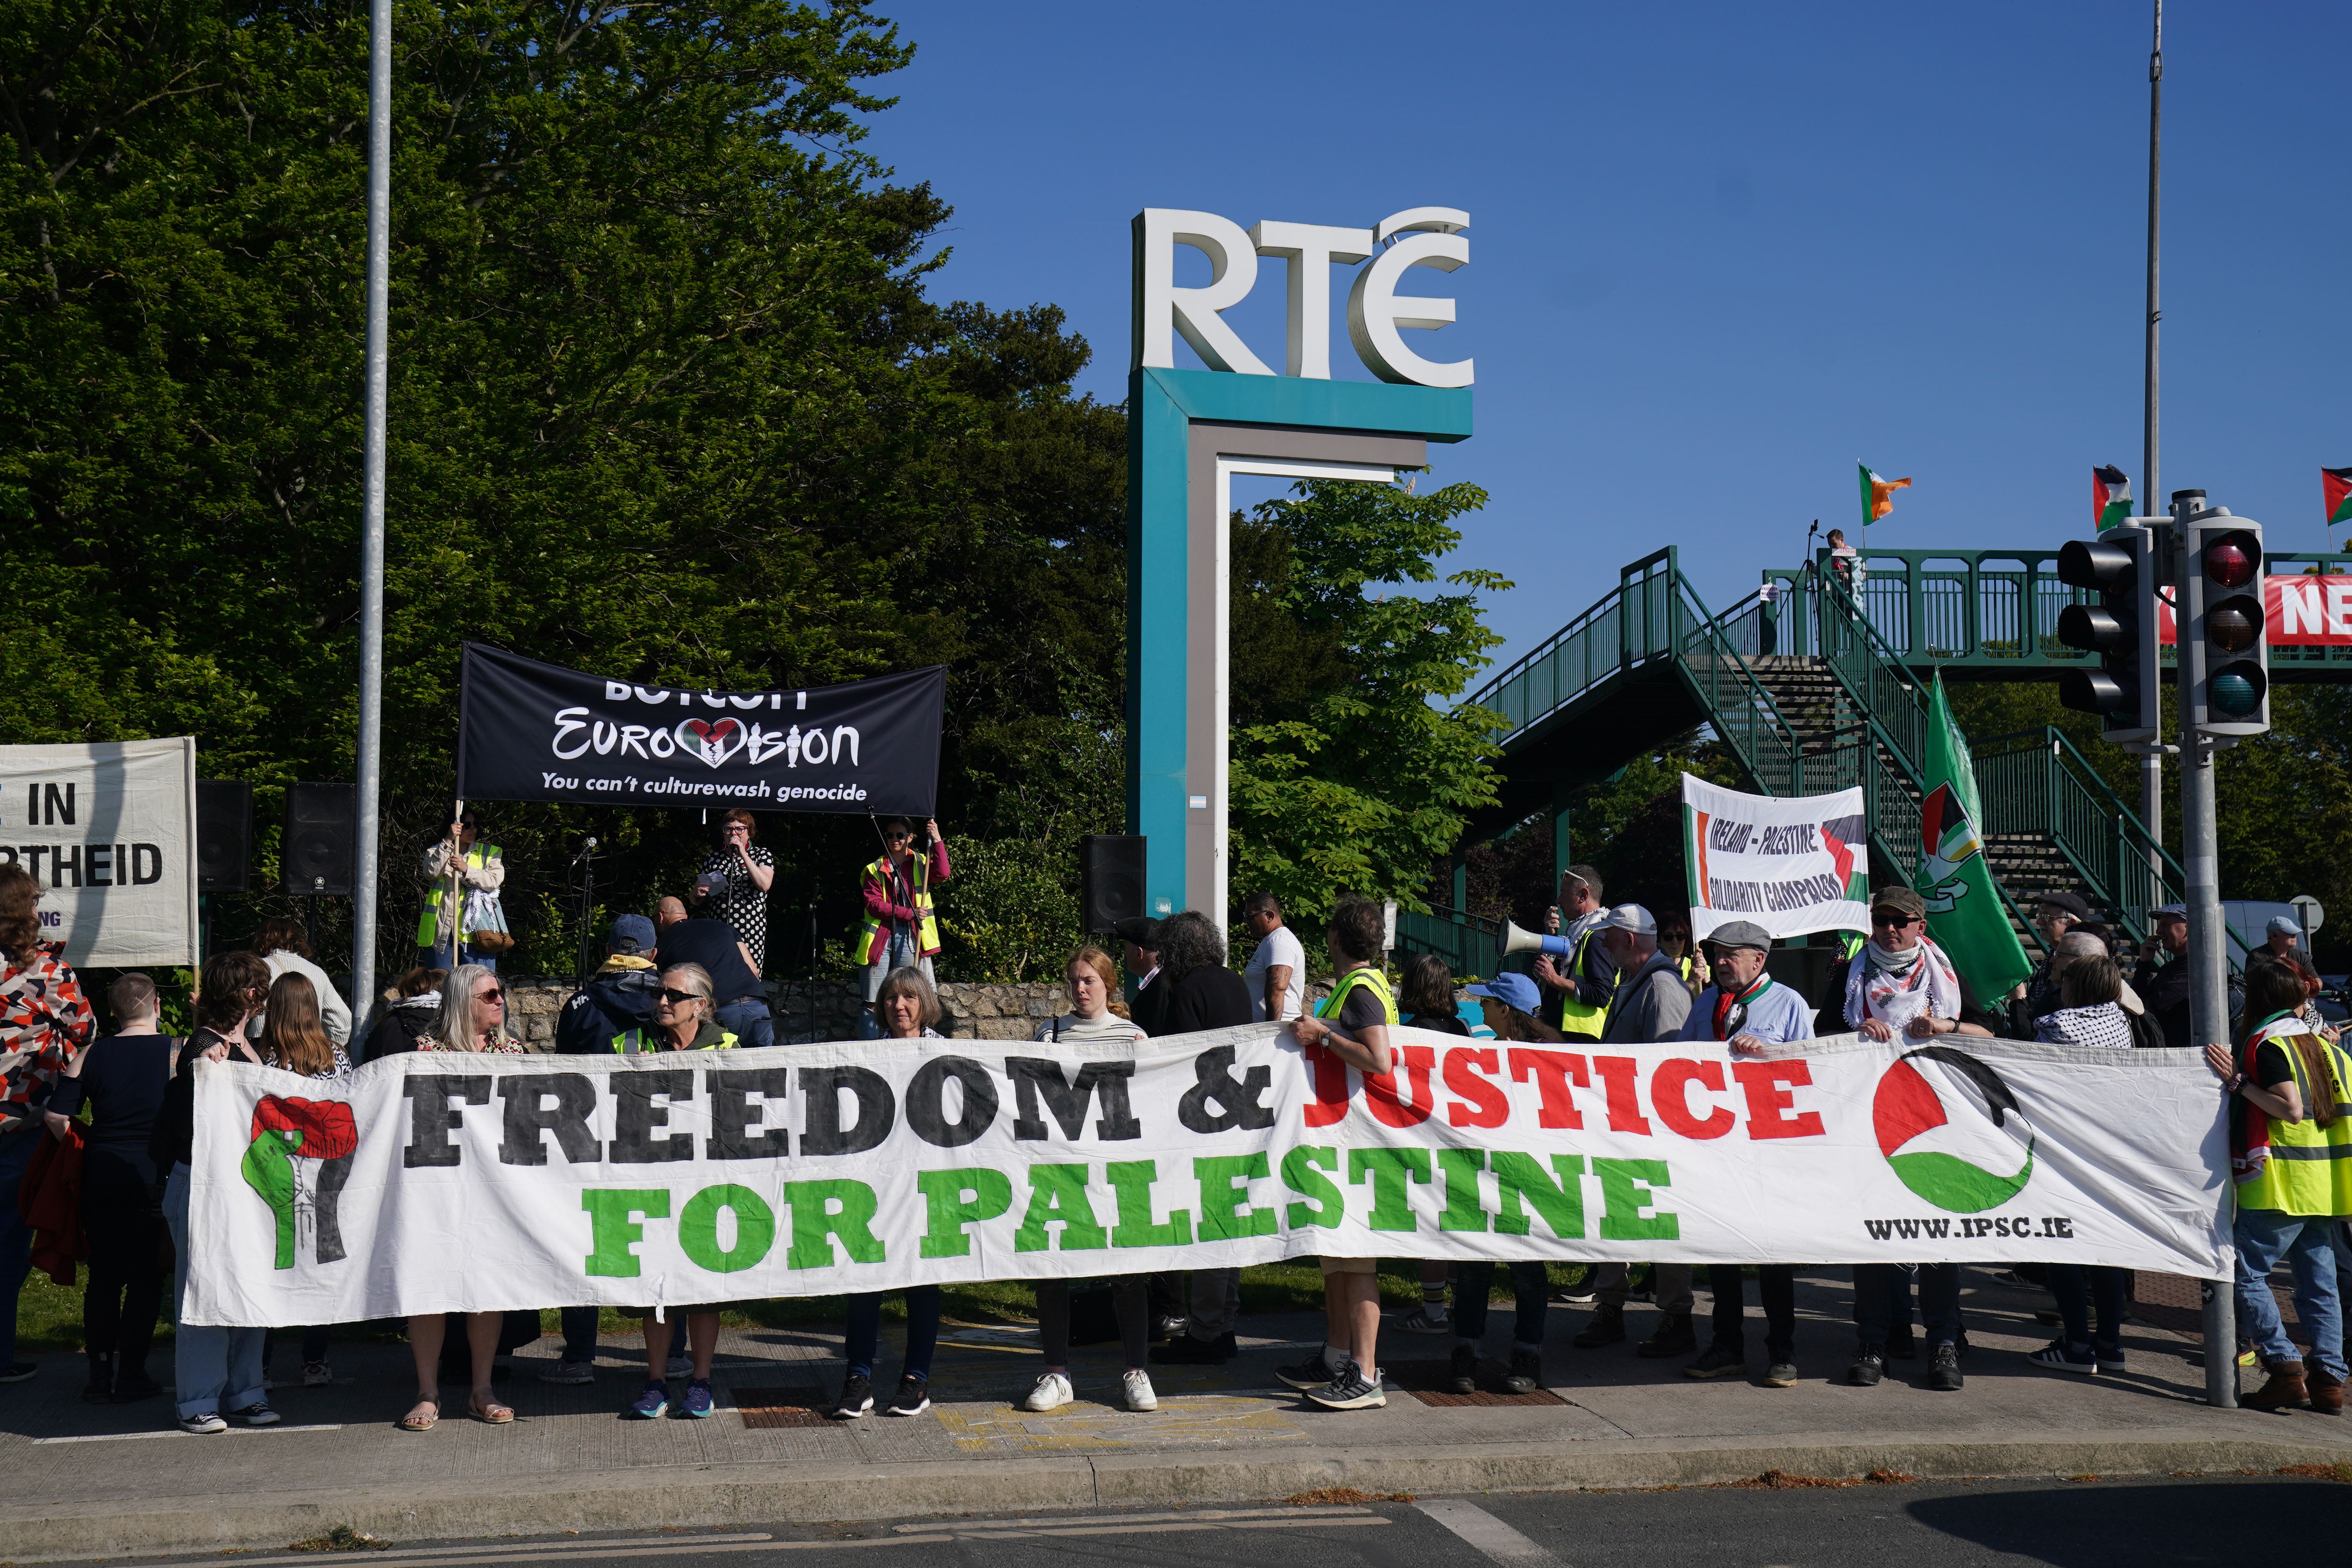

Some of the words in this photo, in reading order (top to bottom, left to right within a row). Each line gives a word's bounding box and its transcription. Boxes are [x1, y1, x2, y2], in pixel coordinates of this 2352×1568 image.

[1131, 207, 1475, 388] RTÉ
[28, 783, 76, 825] IN
[542, 772, 579, 789] You
[585, 776, 638, 792] can't
[643, 777, 770, 797] culturewash
[776, 783, 867, 802] genocide
[1710, 818, 1753, 853] IRELAND
[1757, 824, 1819, 855] PALESTINE
[1710, 877, 1764, 912] SOLIDARITY
[1763, 873, 1842, 912] CAMPAIGN
[403, 1055, 1142, 1168] FREEDOM
[1178, 1045, 1275, 1134] &
[1303, 1044, 1826, 1140] JUSTICE
[582, 1179, 886, 1277] FOR
[918, 1144, 1679, 1258] PALESTINE
[1864, 1217, 2073, 1240] WWW.IPSC.IE
